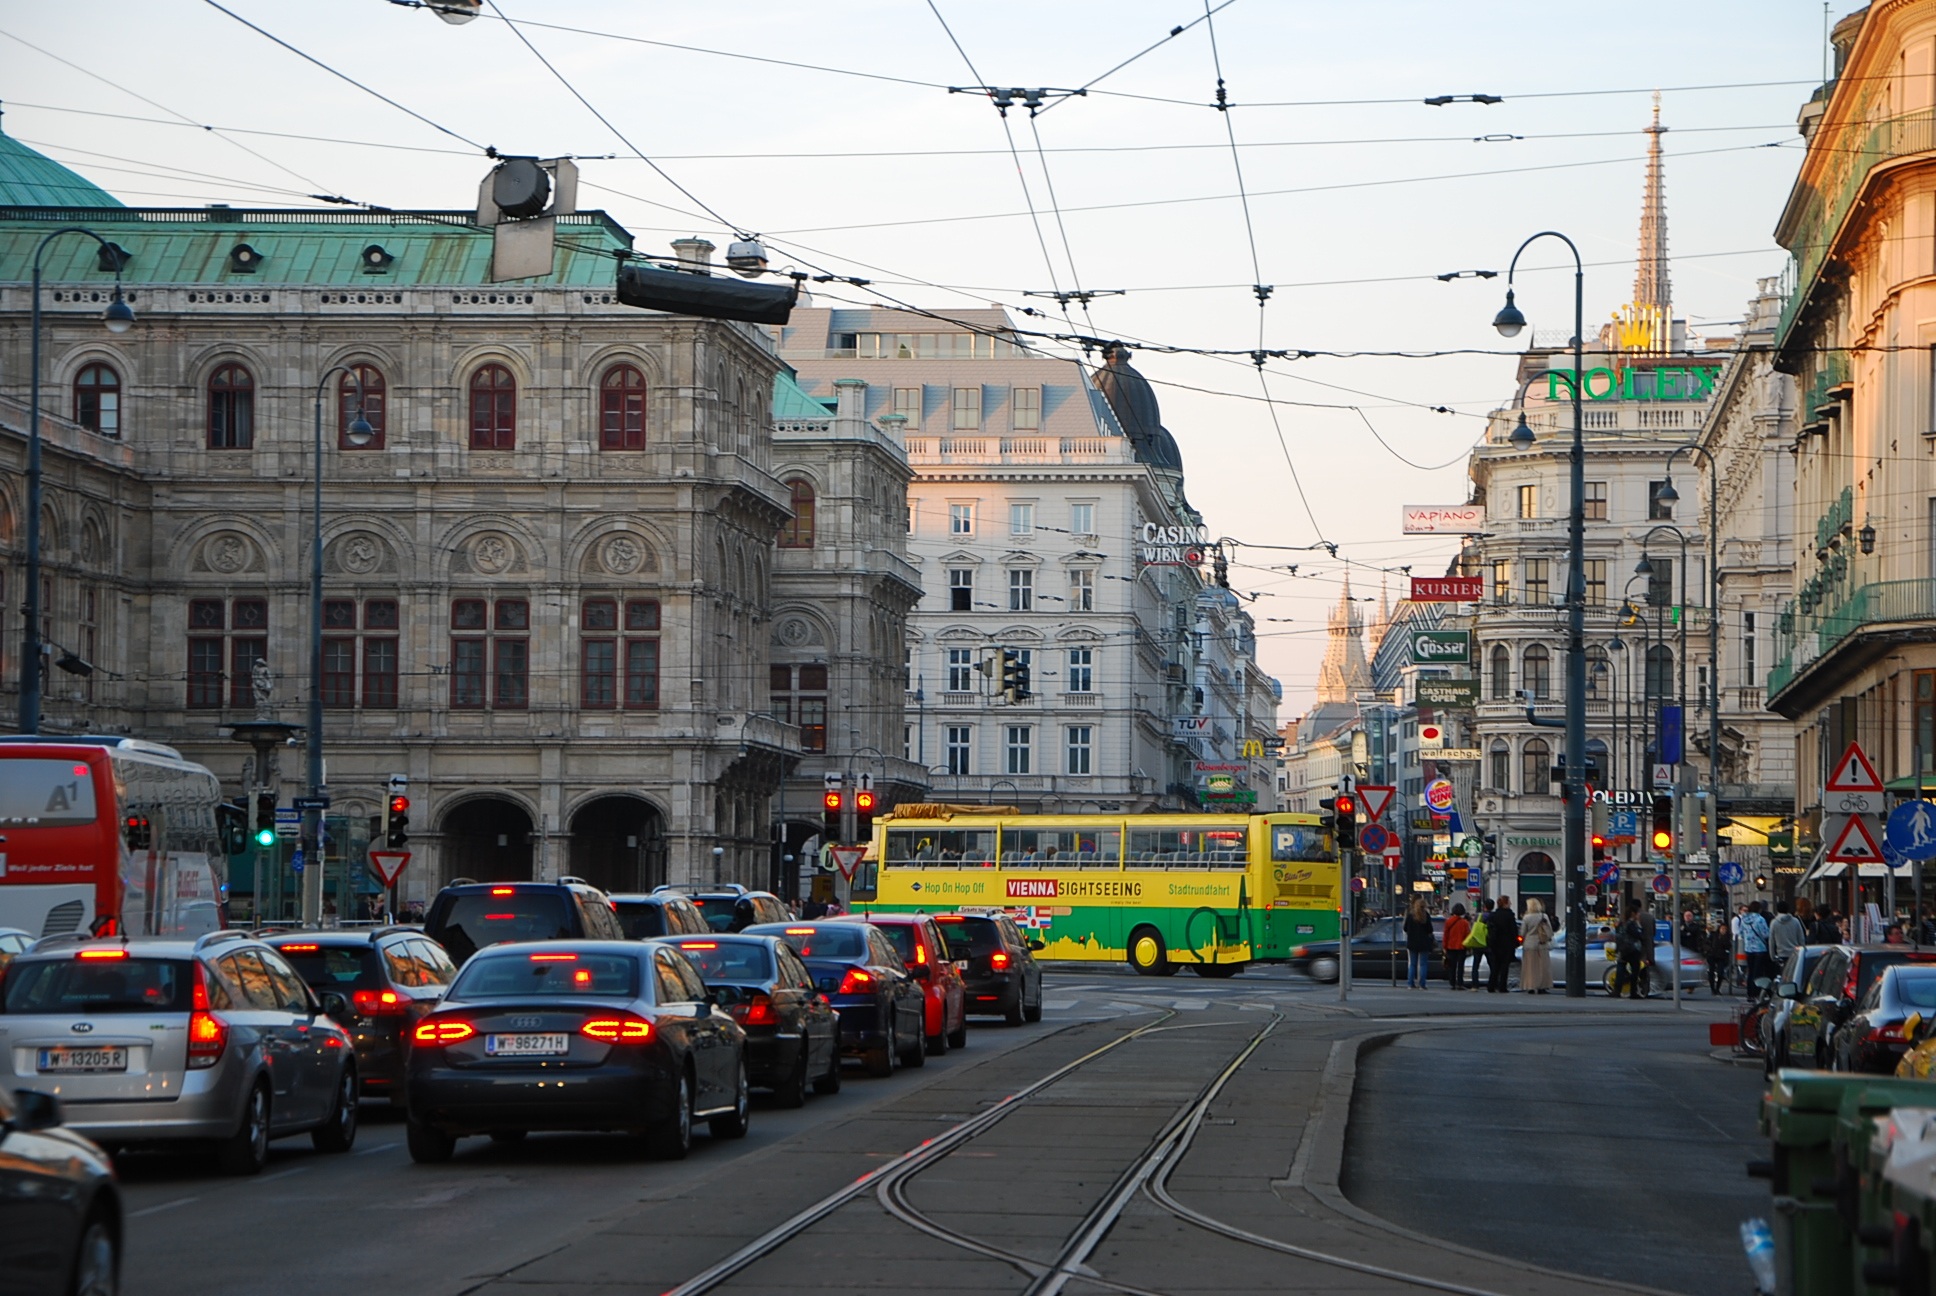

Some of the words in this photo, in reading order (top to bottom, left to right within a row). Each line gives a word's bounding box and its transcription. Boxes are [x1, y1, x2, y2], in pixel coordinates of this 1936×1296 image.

[1546, 366, 1722, 400] ROLEX
[1142, 522, 1209, 544] CASINO
[1142, 547, 1180, 562] WIEN
[1415, 583, 1483, 596] KURIER
[1415, 635, 1465, 658] Gösser
[1420, 688, 1471, 696] GASTHAUS
[1430, 694, 1457, 703] OPER
[1196, 761, 1247, 774] Rosenberger
[925, 882, 940, 894] Hop
[943, 883, 952, 893] On
[955, 882, 970, 894] Hop
[973, 882, 984, 893] Off
[1008, 881, 1055, 896] VIENNA
[1058, 882, 1141, 896] SIGHTSEEING
[1169, 883, 1230, 896] Stadtrundfahrt
[497, 1037, 505, 1049] W
[51, 1053, 60, 1065] W
